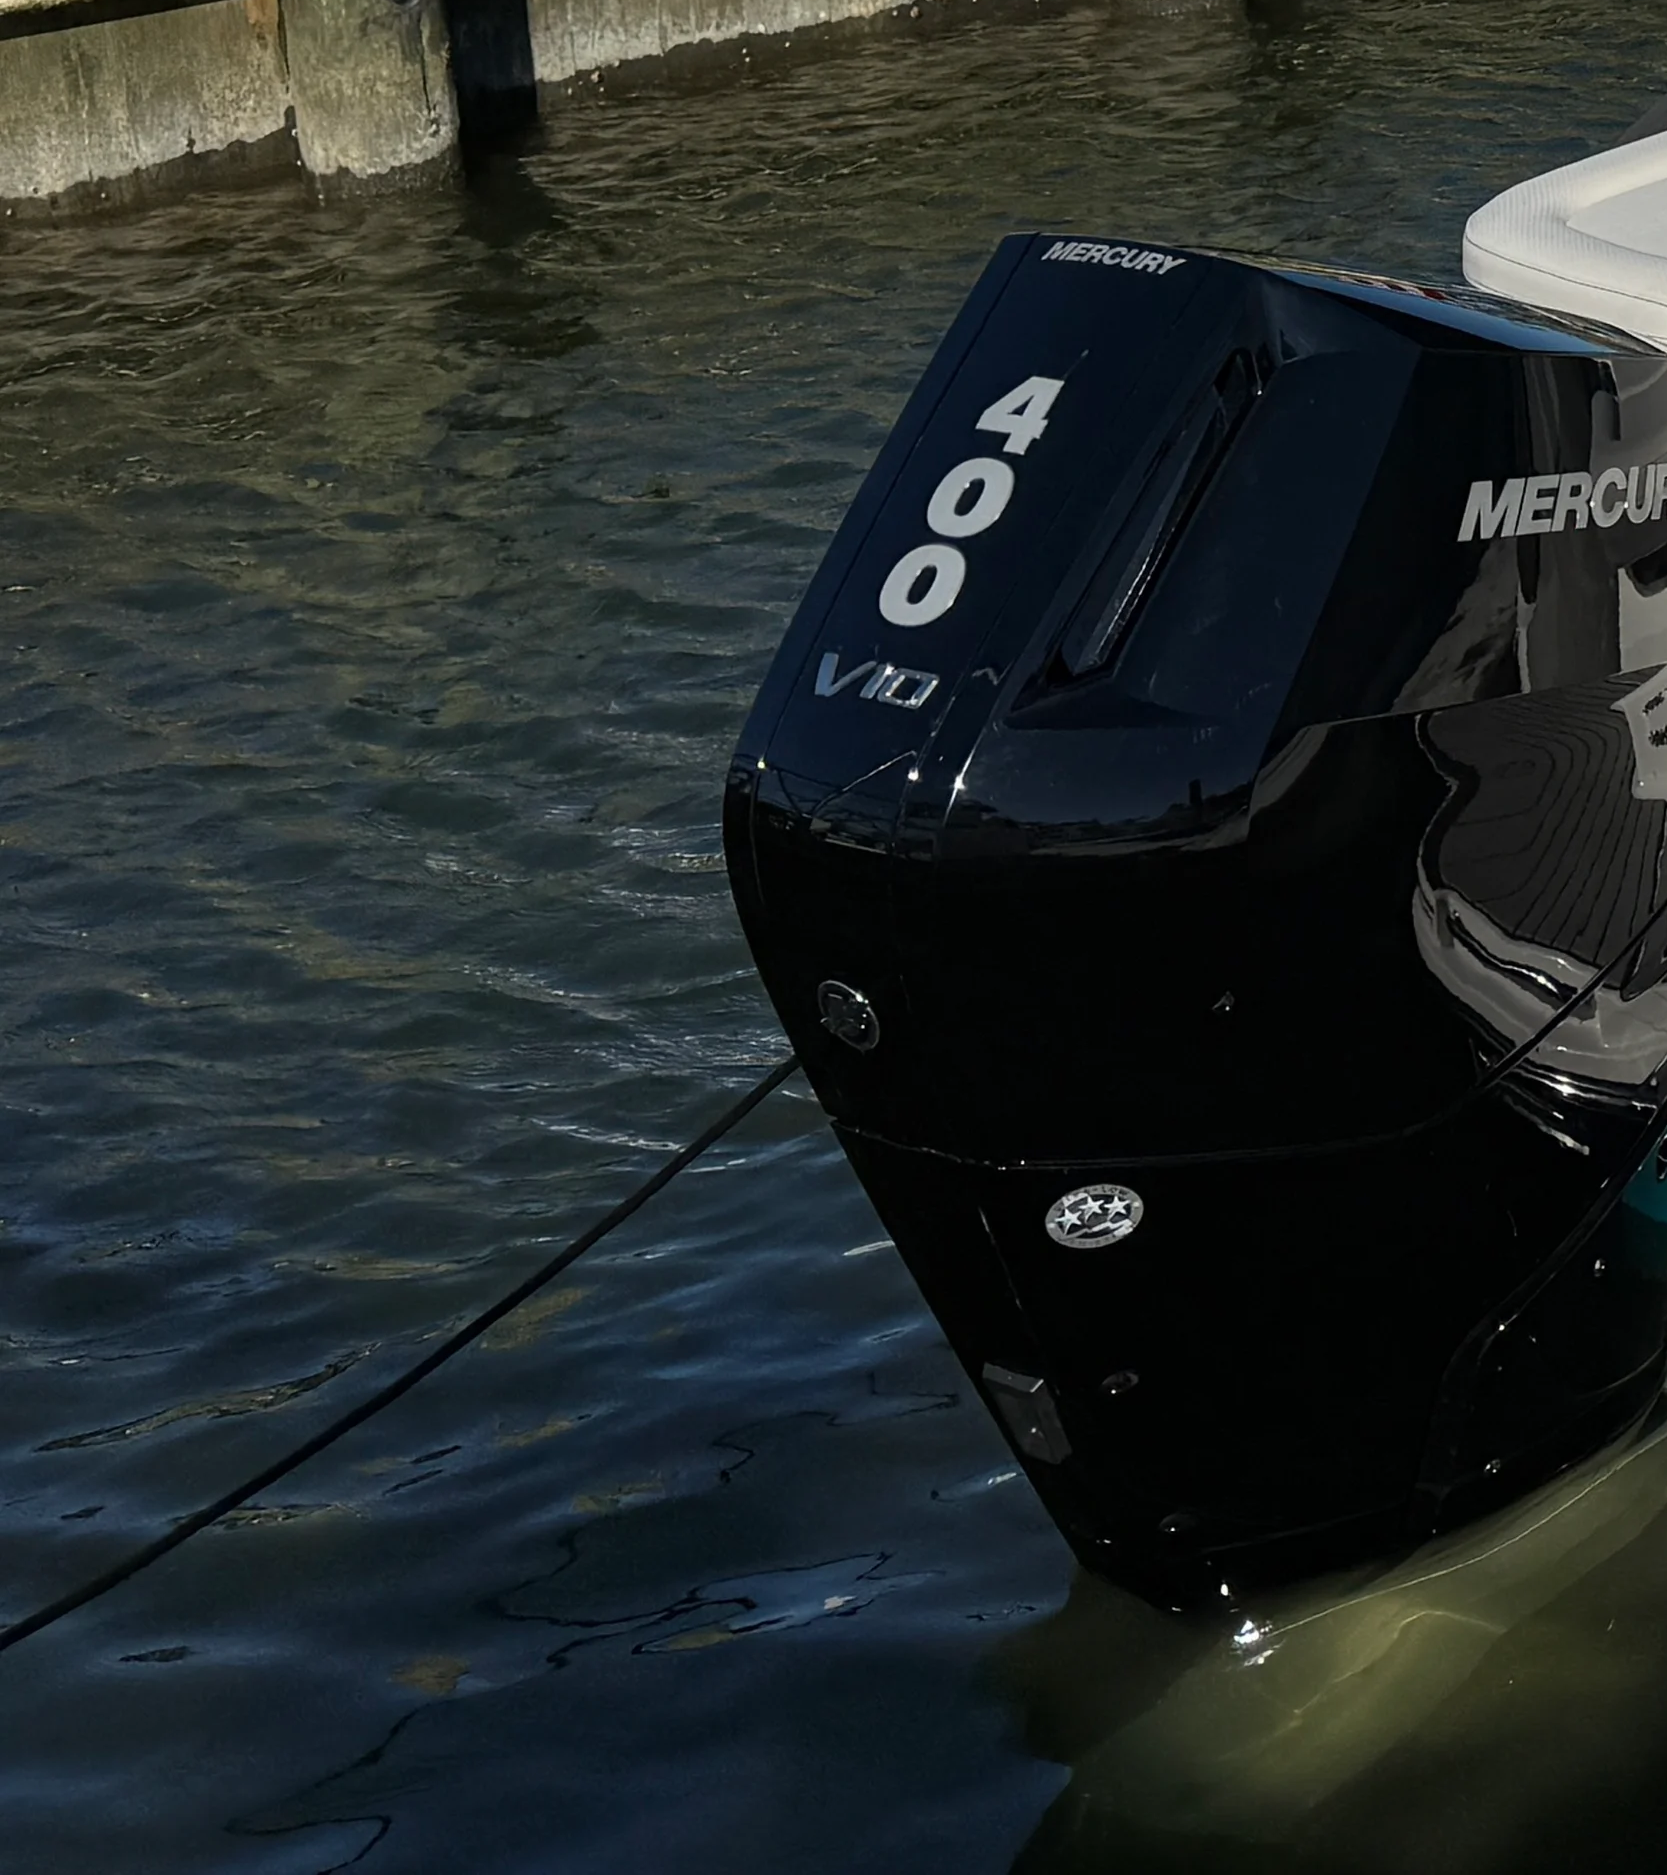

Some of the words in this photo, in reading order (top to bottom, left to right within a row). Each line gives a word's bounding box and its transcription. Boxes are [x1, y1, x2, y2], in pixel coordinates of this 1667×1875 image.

[1041, 241, 1187, 275] MERCURY
[879, 375, 1065, 627] 400
[814, 652, 941, 710] V10
